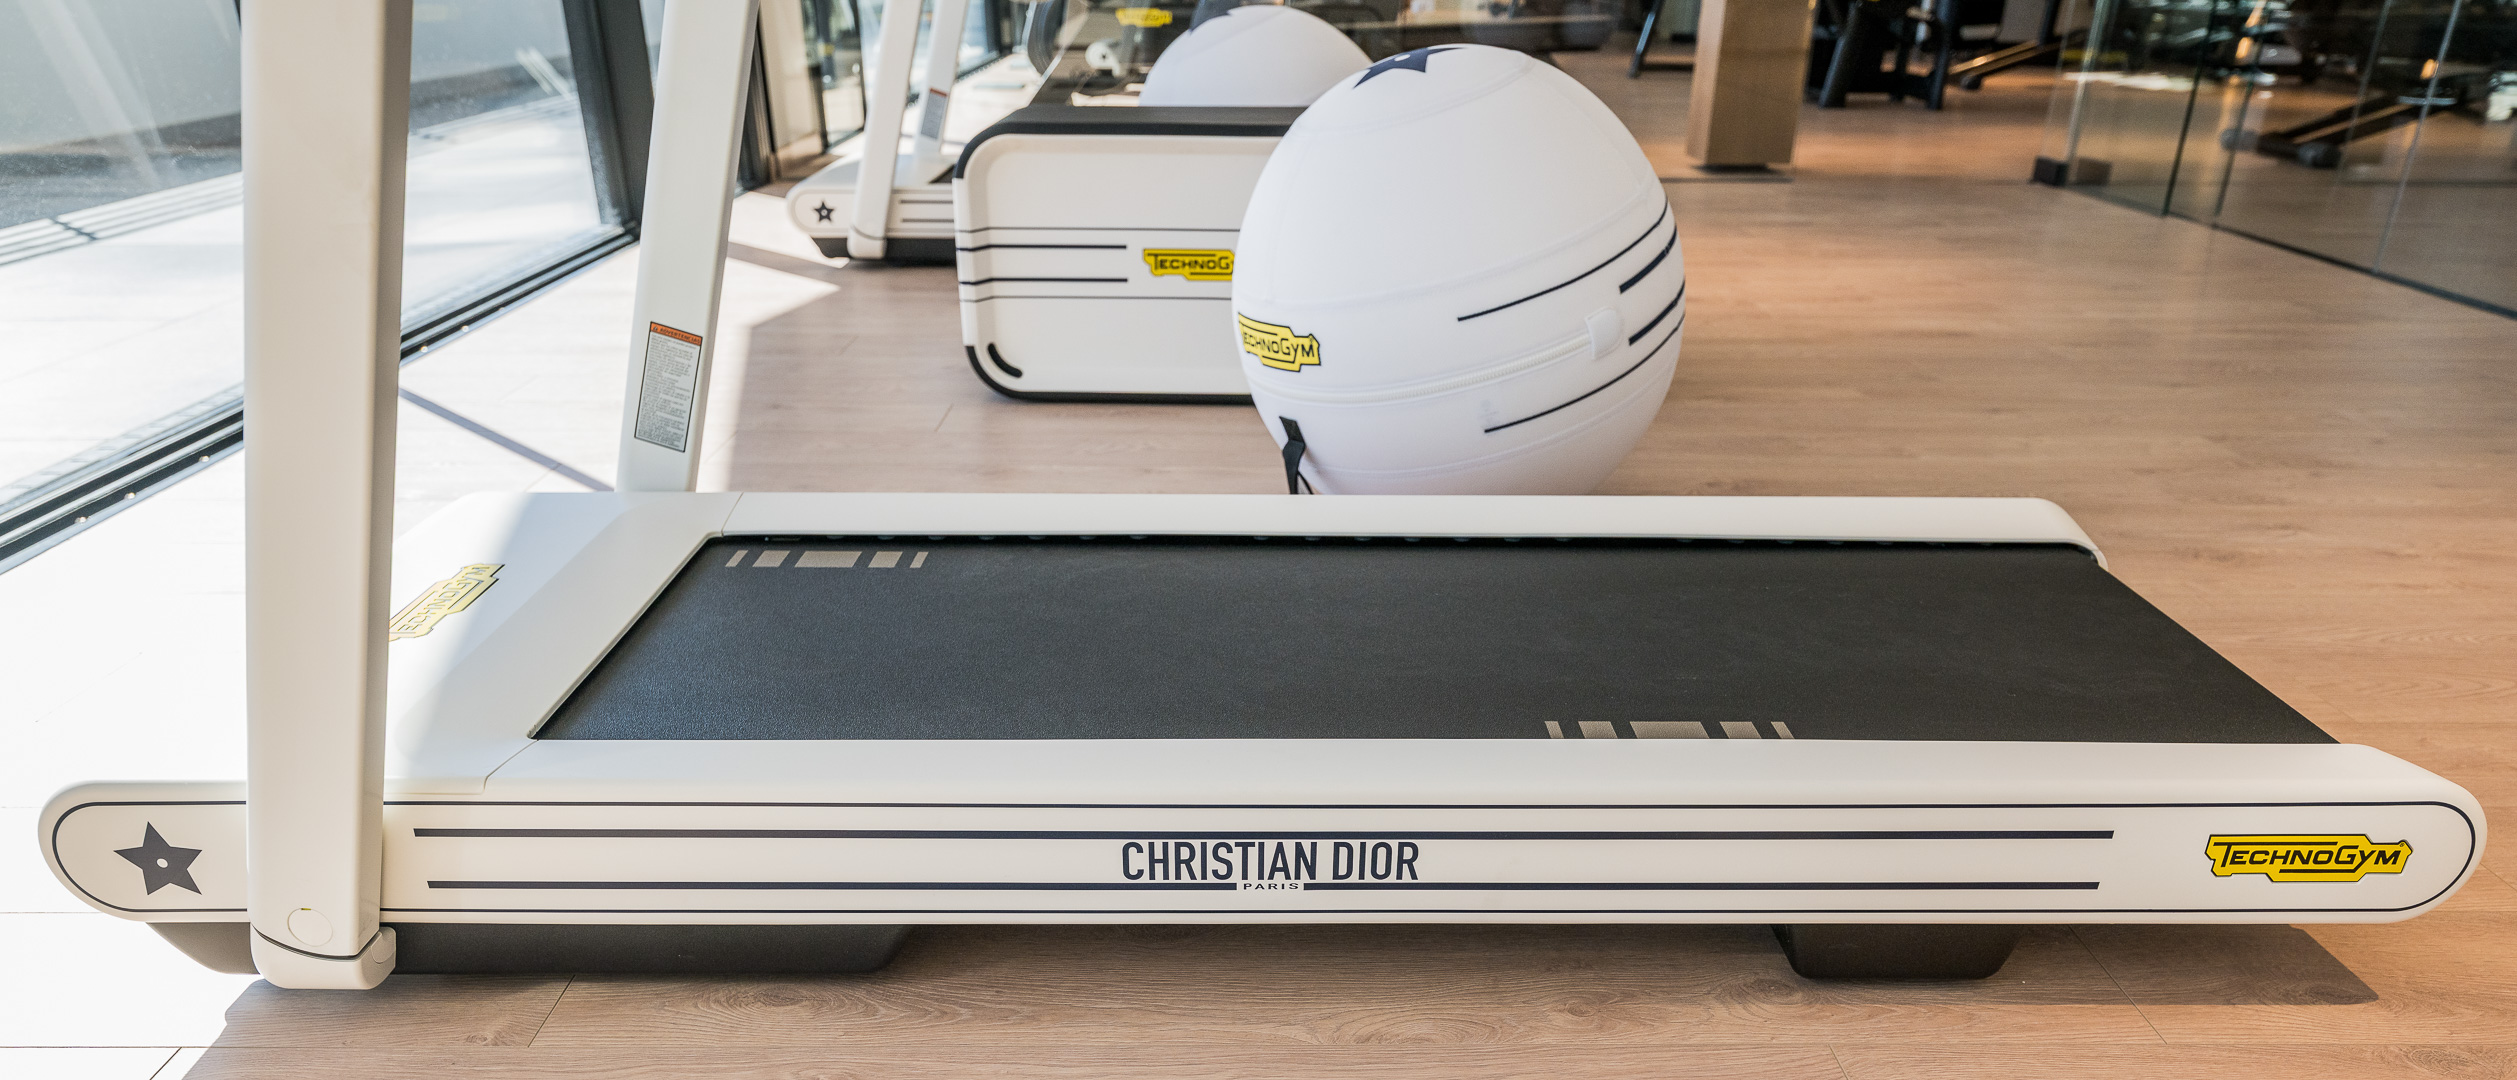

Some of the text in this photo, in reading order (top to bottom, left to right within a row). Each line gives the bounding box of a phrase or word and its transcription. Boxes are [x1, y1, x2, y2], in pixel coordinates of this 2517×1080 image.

[1147, 253, 1232, 274] TECHNOG
[1122, 842, 1419, 880] CHRISTIAN DIOR
